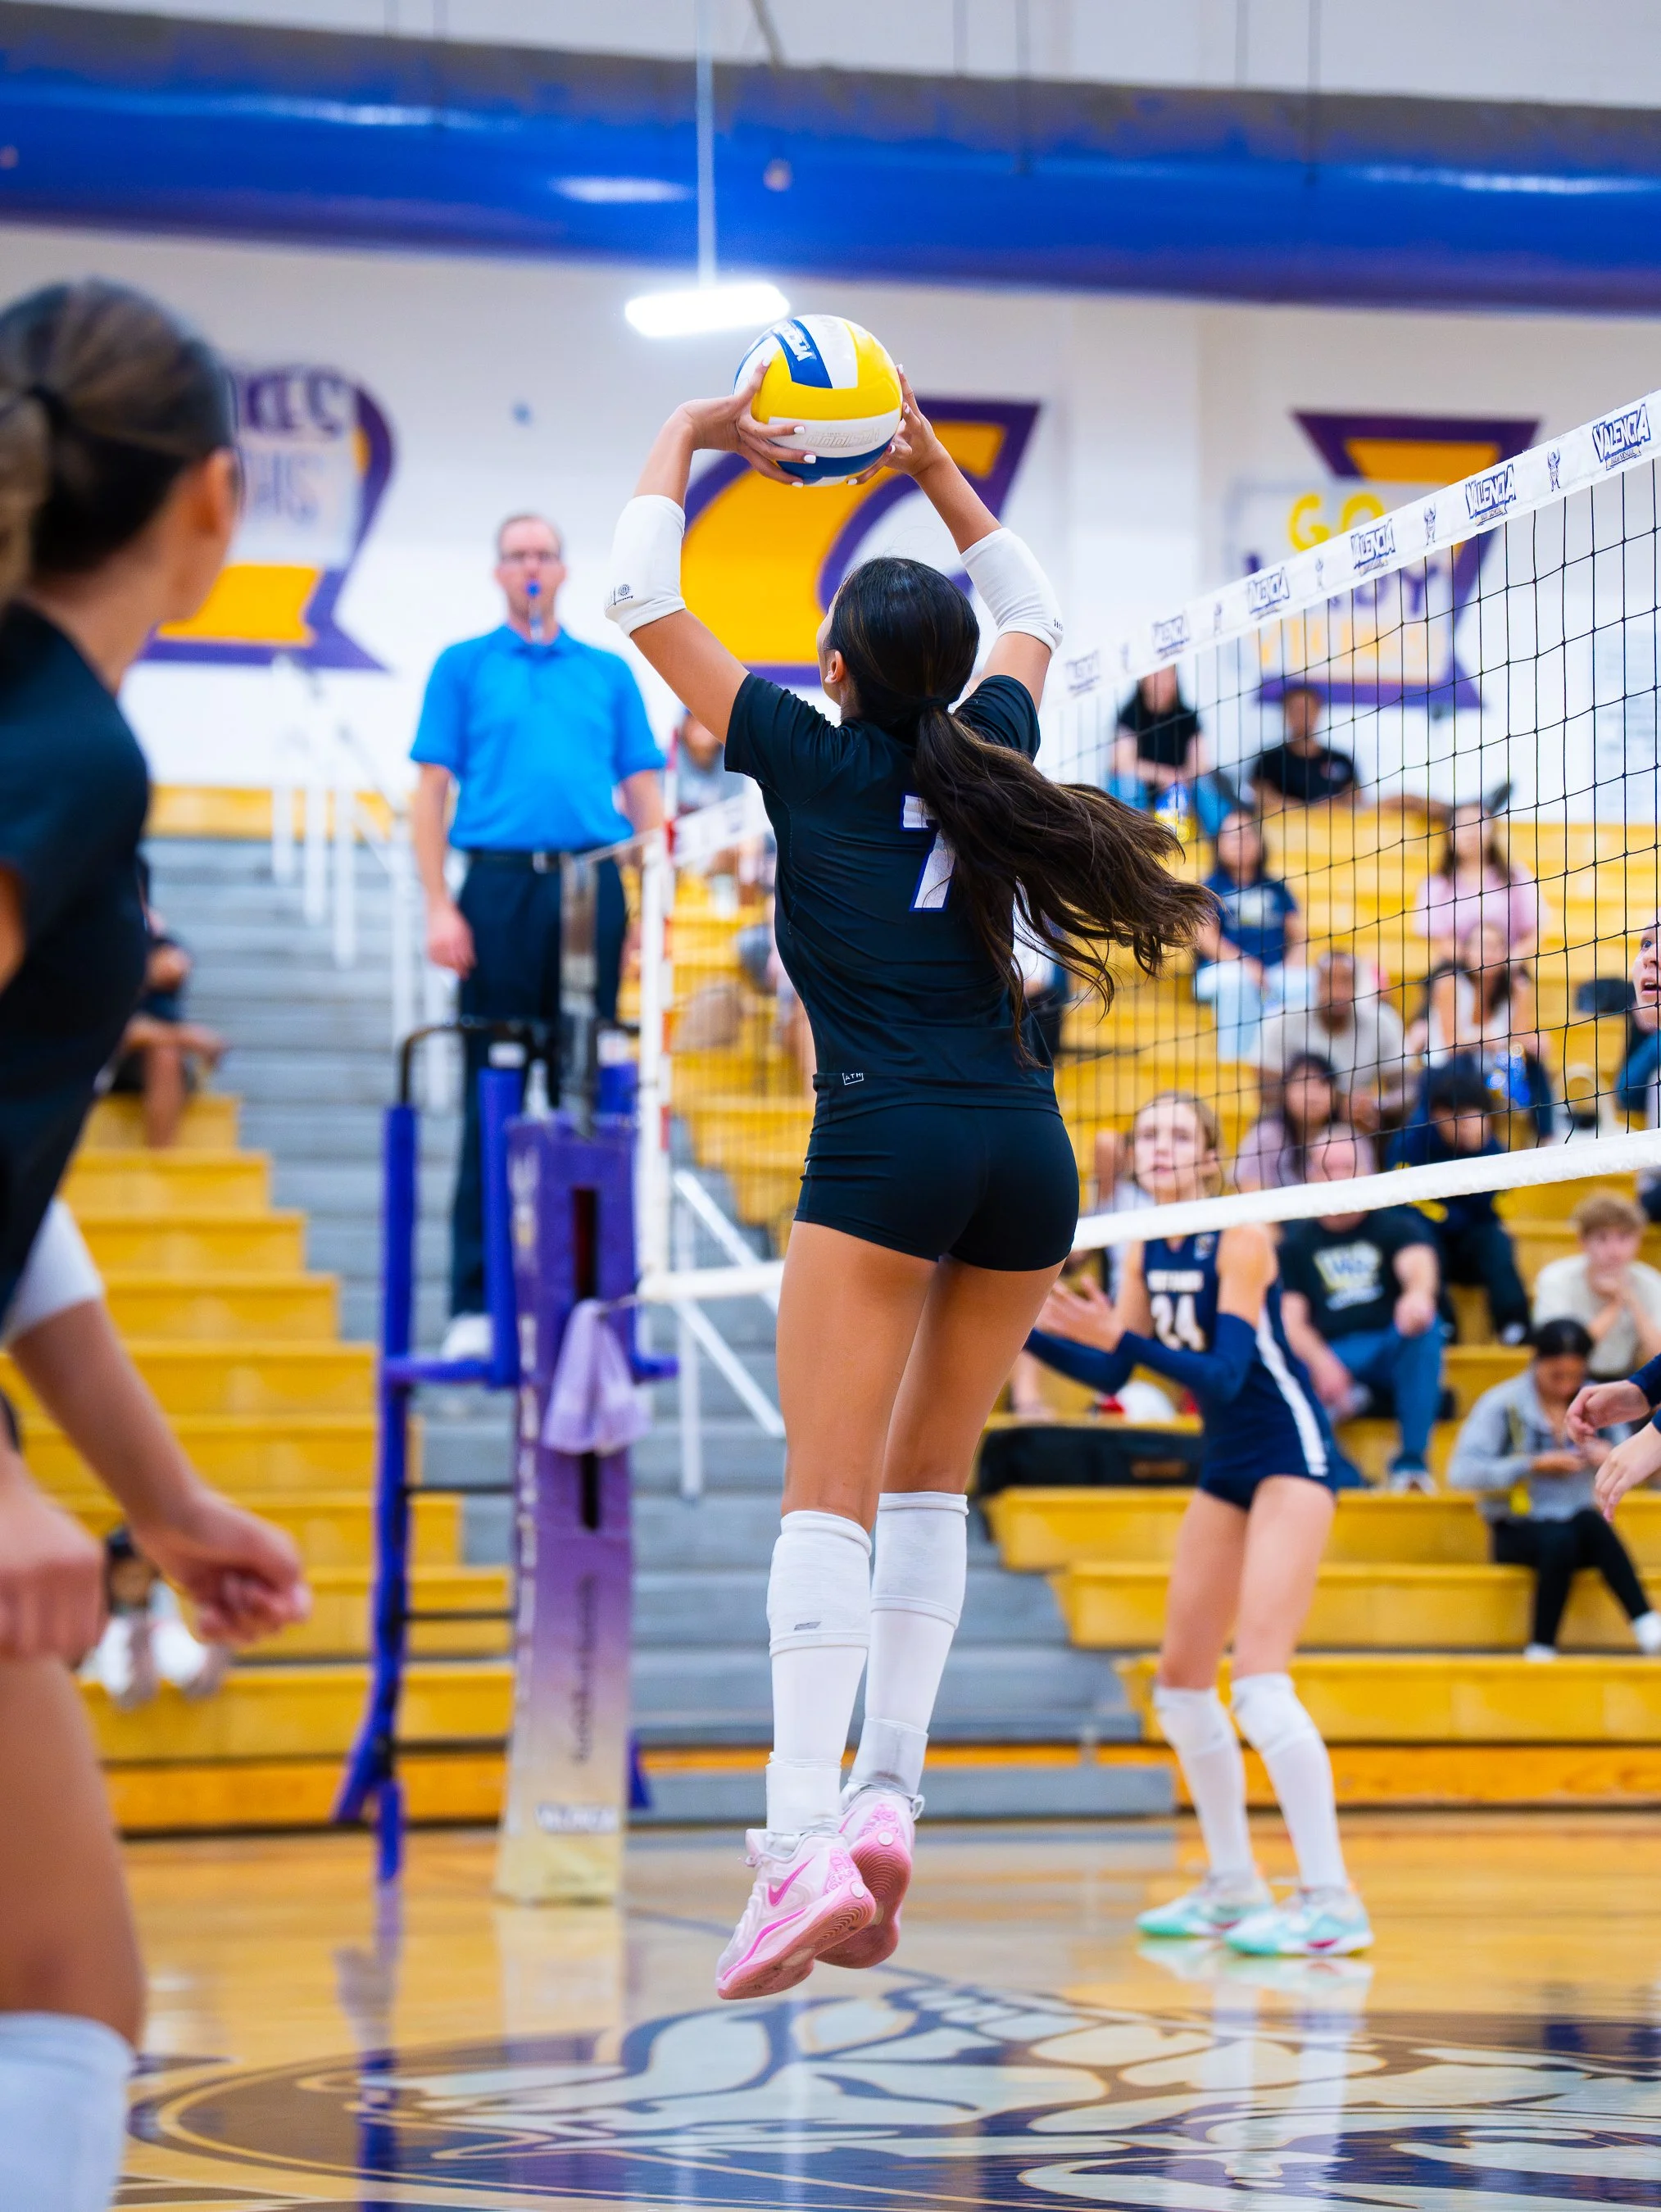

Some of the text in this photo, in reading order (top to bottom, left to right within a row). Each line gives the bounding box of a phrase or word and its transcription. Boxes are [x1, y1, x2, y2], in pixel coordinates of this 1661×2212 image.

[1592, 403, 1651, 463] VALENCIA
[1464, 463, 1517, 519] VALENCIA
[1149, 1292, 1207, 1353] 24
